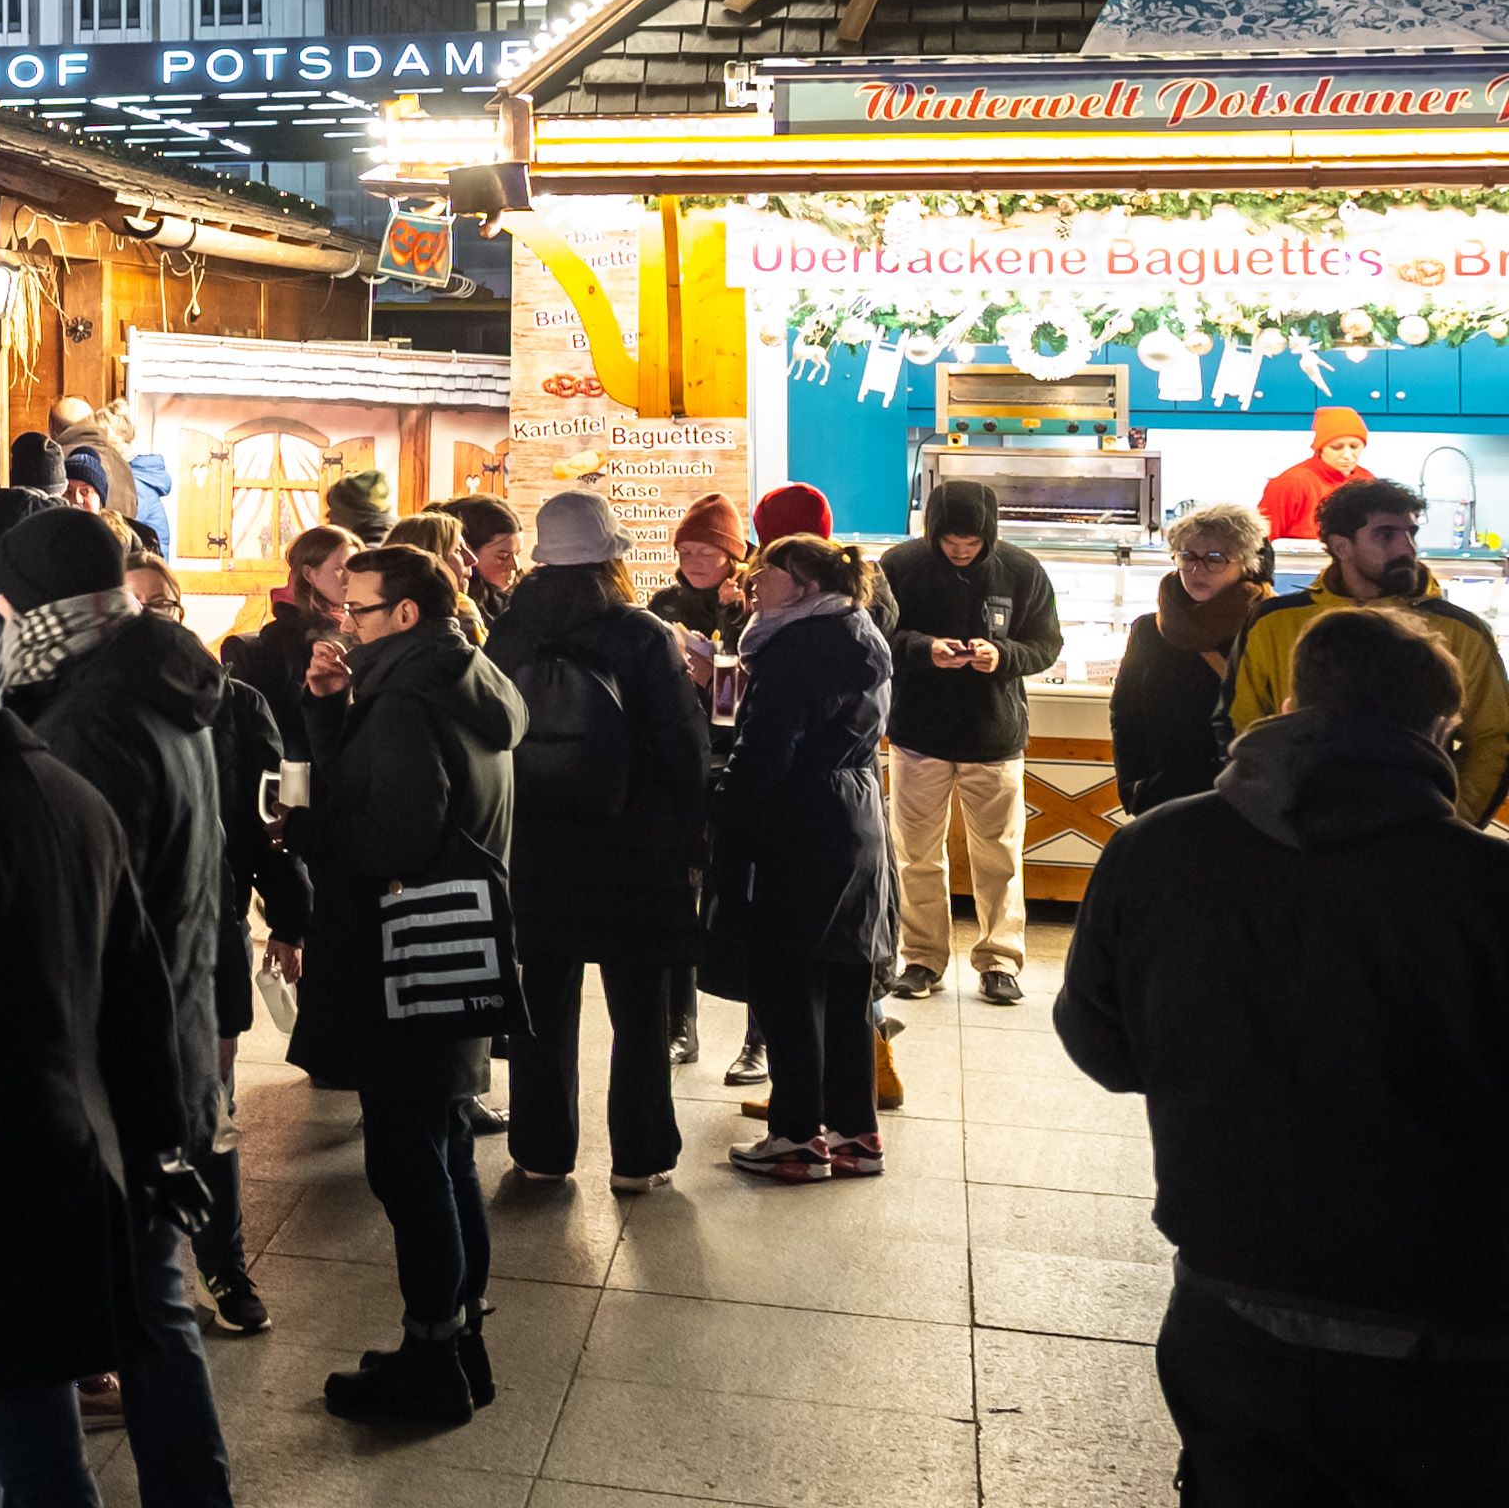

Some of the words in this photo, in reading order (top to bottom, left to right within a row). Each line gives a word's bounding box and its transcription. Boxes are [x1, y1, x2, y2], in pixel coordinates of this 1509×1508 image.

[854, 79, 1144, 121] Winterwelt
[1156, 76, 1473, 128] Potsdamer
[1107, 237, 1382, 286] Baguettes
[514, 416, 606, 438] Kartoffel
[612, 427, 732, 449] Baguettes:
[611, 461, 713, 475] Knoblauch
